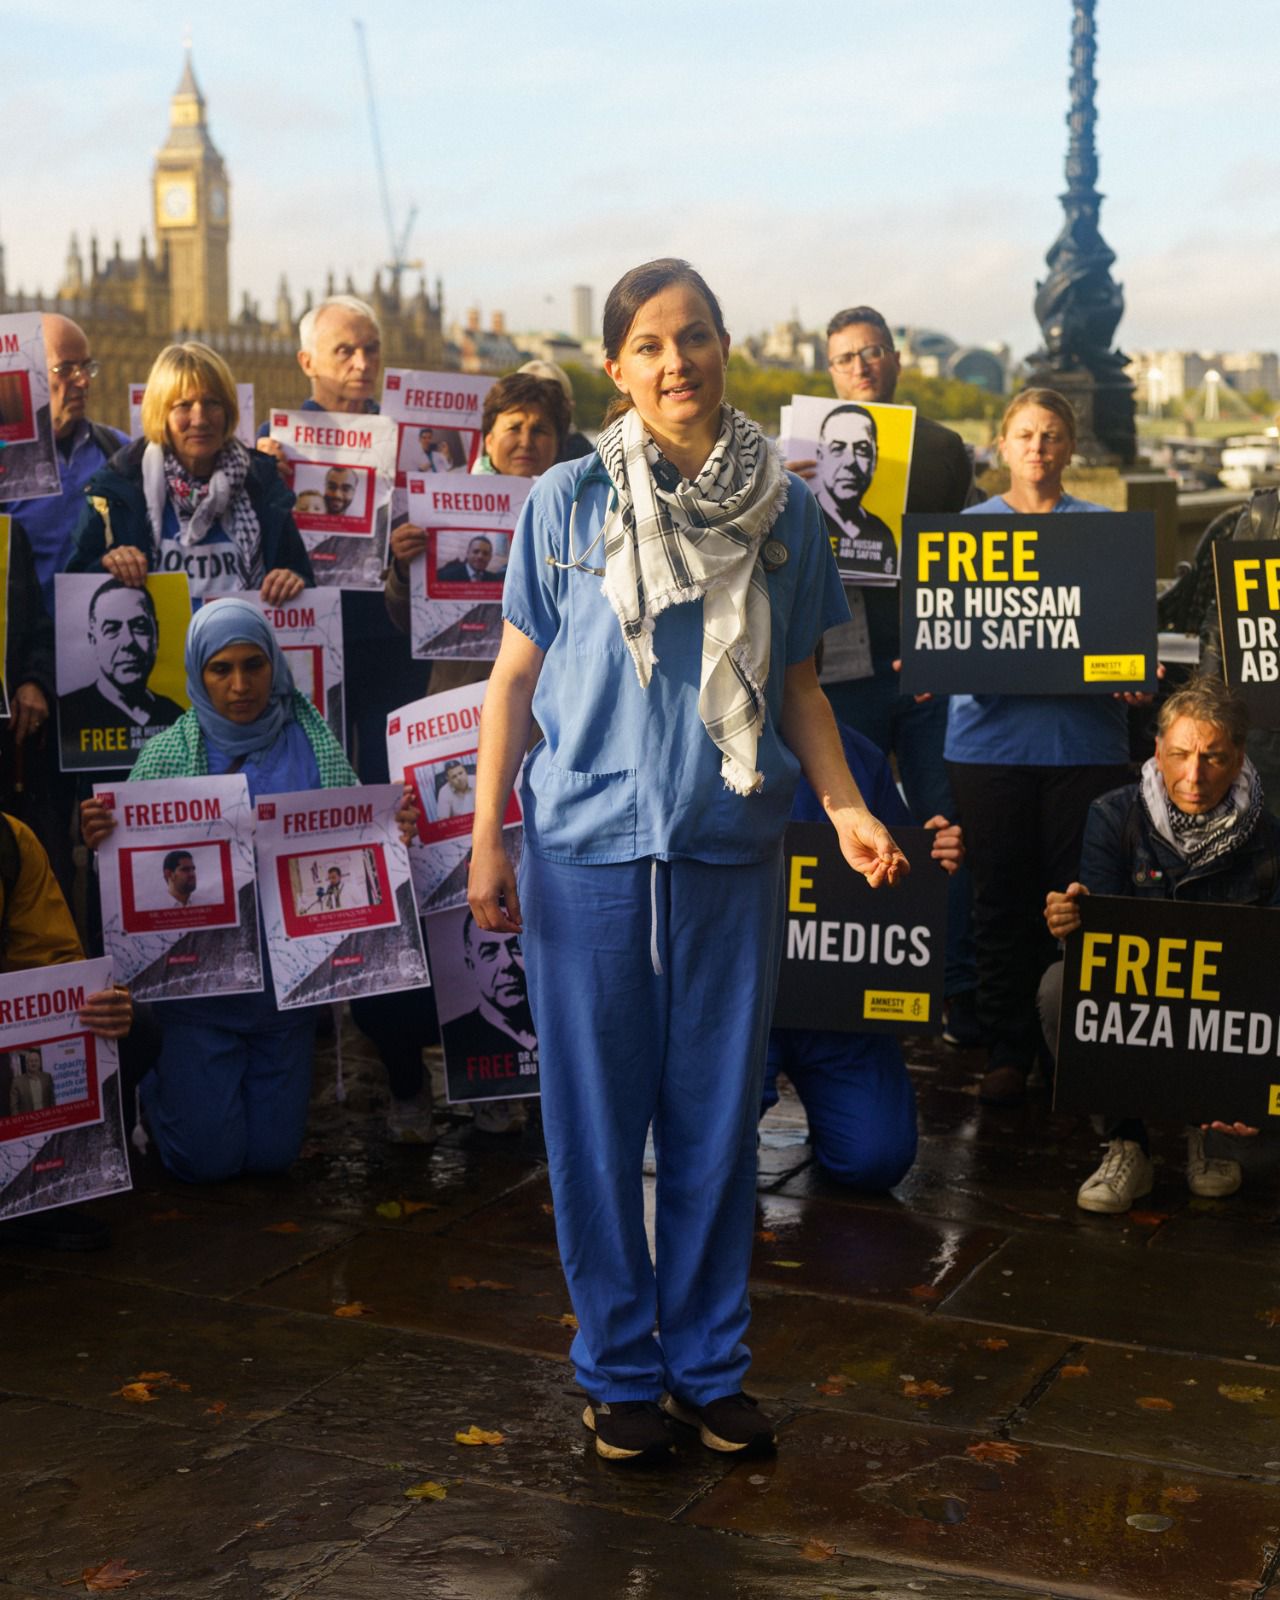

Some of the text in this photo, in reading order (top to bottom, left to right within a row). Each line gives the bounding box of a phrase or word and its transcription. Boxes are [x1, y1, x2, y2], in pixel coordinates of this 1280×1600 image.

[404, 388, 478, 411] FREEDOM
[294, 426, 372, 448] FREEDOM
[432, 491, 511, 512] FREEDOM
[918, 531, 1040, 582] FREE
[916, 586, 1081, 618] DR HUSSAM
[915, 618, 1081, 650] ABU SAFIYA
[1236, 616, 1279, 649] DR
[80, 727, 128, 752] FREE
[124, 798, 222, 828] FREEDOM
[283, 803, 373, 834] FREEDOM
[788, 855, 818, 913] E
[787, 919, 931, 967] MEDICS
[1079, 932, 1223, 1002] FREE
[870, 997, 905, 1007] AMNESTY
[1074, 999, 1174, 1048] GAZA
[466, 1053, 516, 1081] FREE
[519, 1063, 537, 1075] ABU
